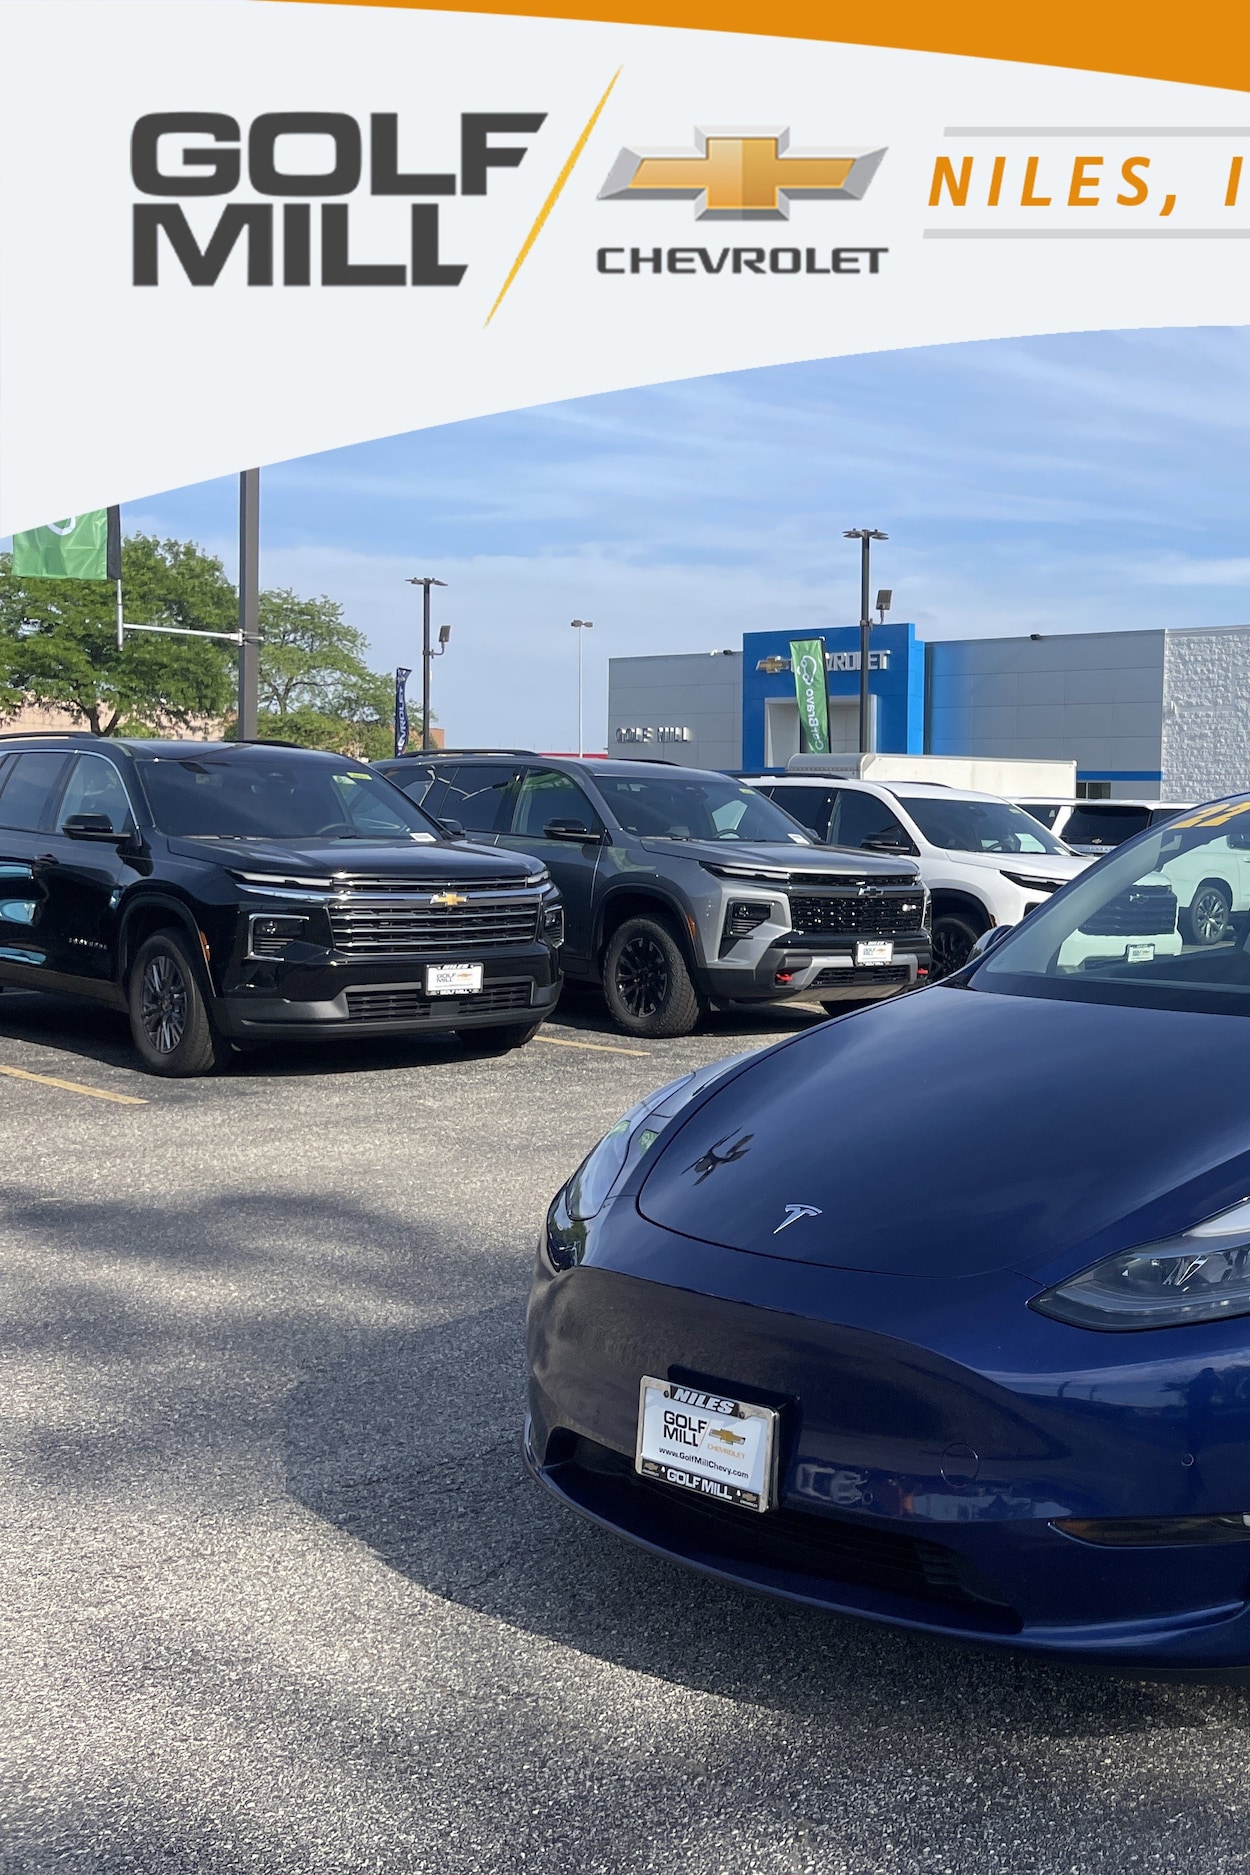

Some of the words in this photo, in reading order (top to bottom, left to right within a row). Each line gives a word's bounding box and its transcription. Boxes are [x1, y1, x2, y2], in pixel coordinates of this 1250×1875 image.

[673, 1388, 735, 1415] NILES
[663, 1410, 708, 1434] GOLF
[663, 1424, 699, 1447] MILL
[659, 1446, 749, 1479] www.GolfMillChevy.com
[666, 1468, 701, 1489] GOLF
[701, 1478, 733, 1500] MILL
